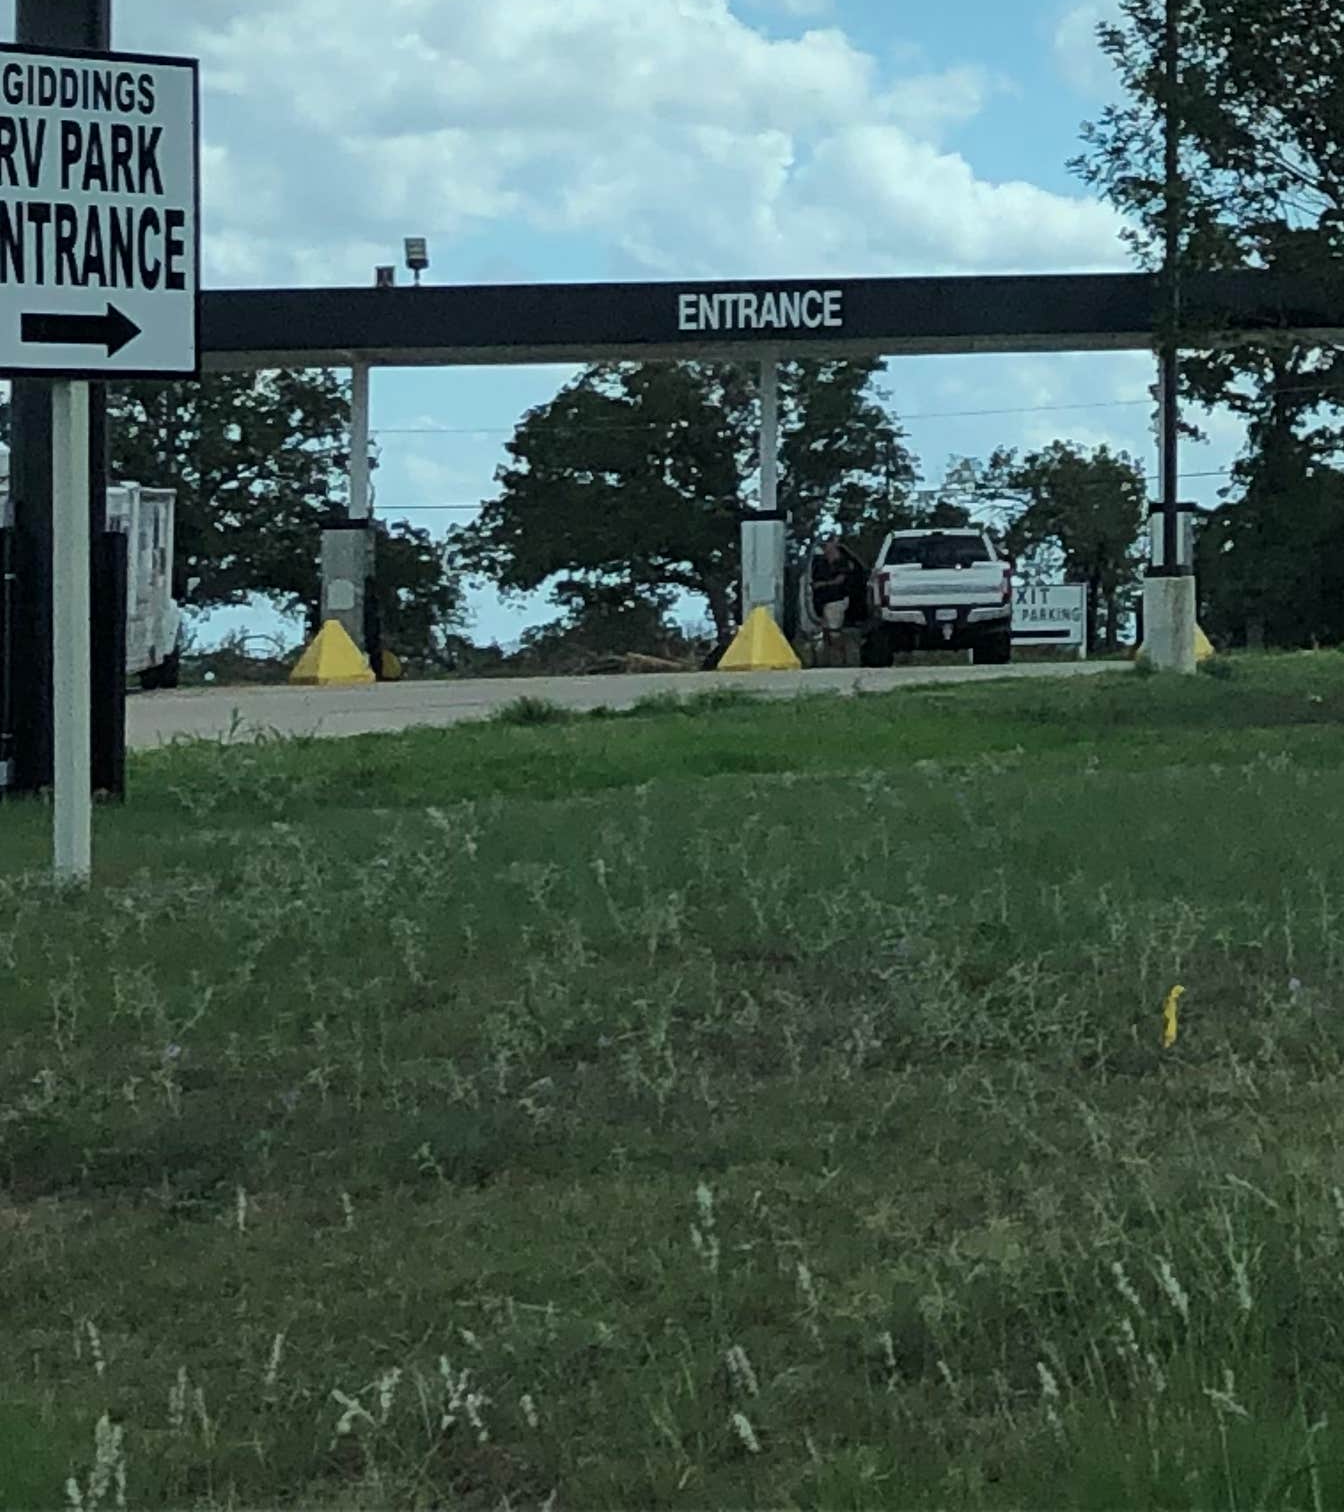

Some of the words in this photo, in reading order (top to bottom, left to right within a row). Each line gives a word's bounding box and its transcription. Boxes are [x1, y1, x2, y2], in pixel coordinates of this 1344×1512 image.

[2, 62, 156, 115] GIDDINGS
[0, 115, 47, 189] RV
[60, 119, 164, 196] PARK
[0, 198, 187, 291] NTRANCE
[677, 289, 843, 331] ENTRANCE
[1022, 606, 1083, 622] PARKING
